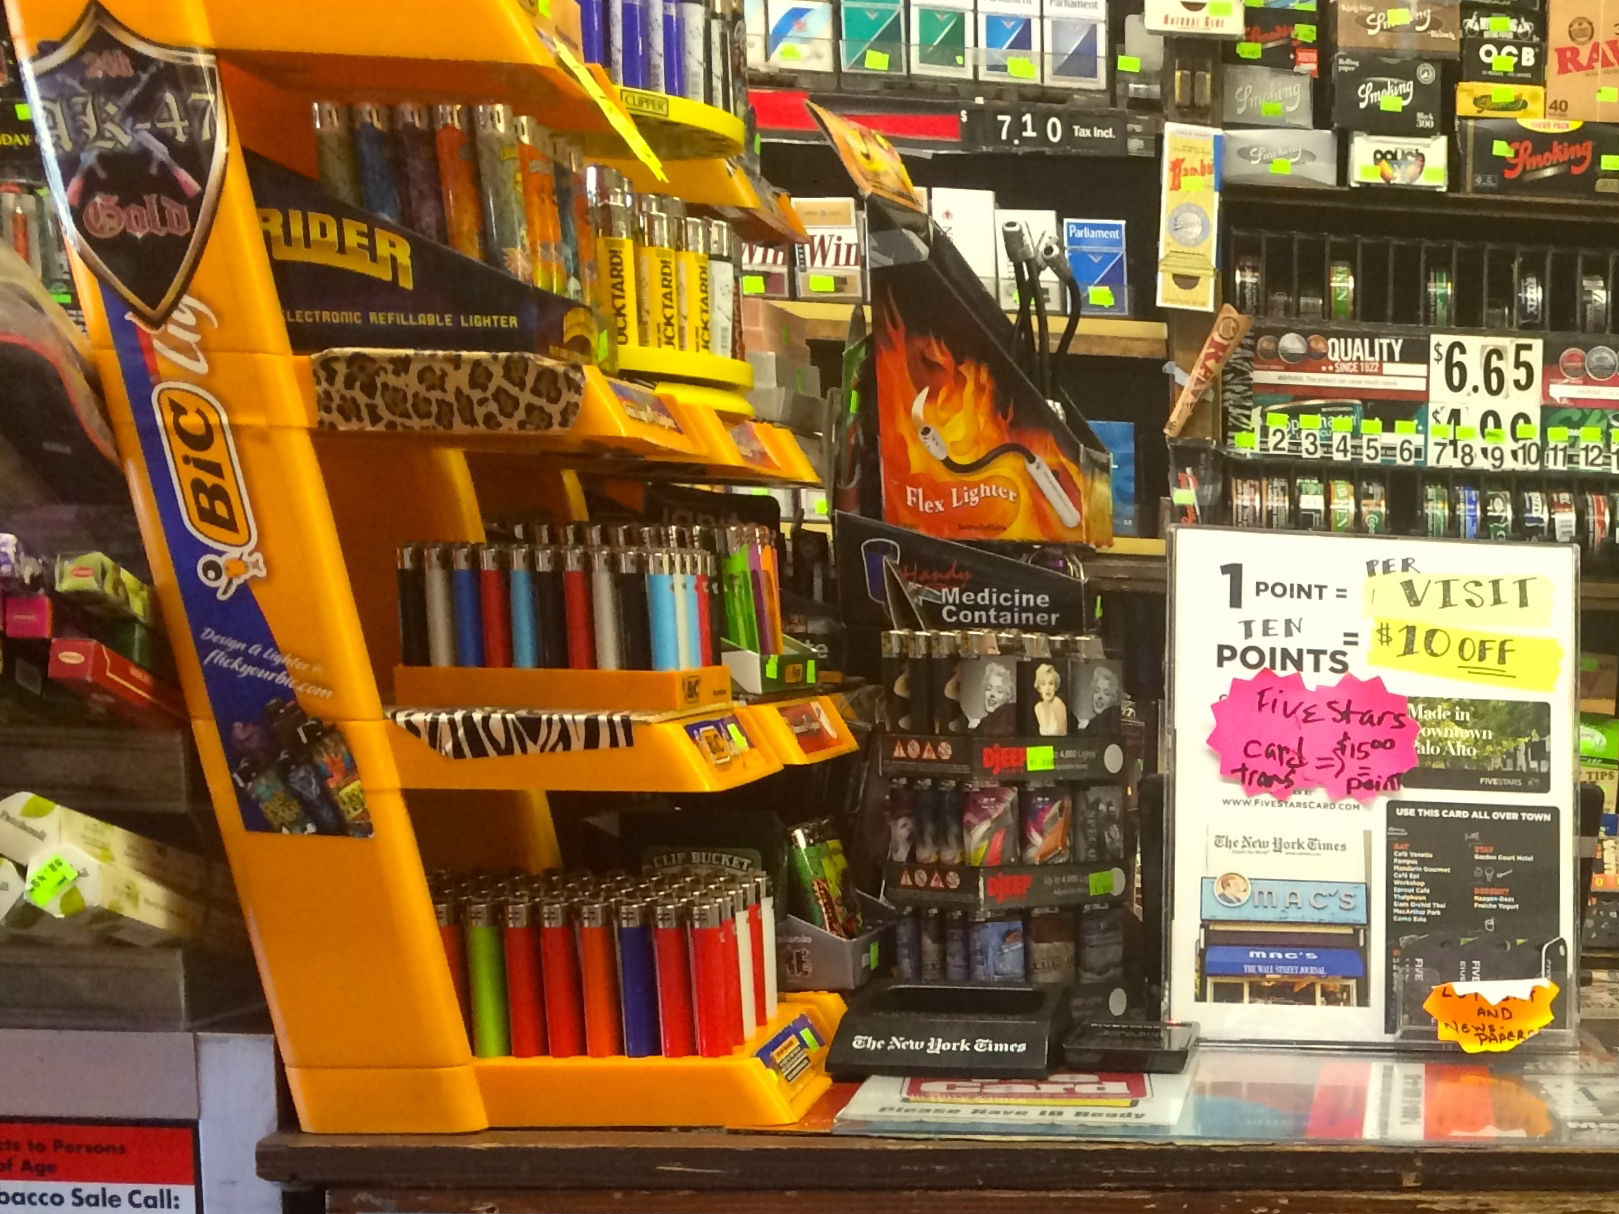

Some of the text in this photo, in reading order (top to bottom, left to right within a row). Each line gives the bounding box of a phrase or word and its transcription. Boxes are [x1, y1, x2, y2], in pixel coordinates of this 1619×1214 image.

[625, 94, 664, 111] CLIPPER
[997, 114, 1062, 145] 7.10
[1505, 138, 1591, 179] Smoking
[83, 194, 191, 238] Gold
[1069, 225, 1120, 239] Parliament
[369, 312, 518, 328] REFILLABLE LIGHTER
[1327, 338, 1403, 362] QUALITY
[1335, 362, 1379, 372] SINCE 1822
[1433, 340, 1535, 396] $6.65
[1272, 428, 1286, 450] 2
[1336, 435, 1350, 458] 4
[1434, 442, 1447, 465] 7
[1518, 442, 1540, 466] 10
[1549, 444, 1567, 467] 11
[169, 398, 239, 535] BiC
[906, 484, 1018, 513] Flex Lighter
[901, 560, 972, 588] Handy
[1366, 557, 1420, 577] PER
[1220, 563, 1328, 609] 1 POINT
[1400, 577, 1537, 608] VISIT
[942, 588, 1050, 607] Medicine
[942, 606, 1060, 626] Container
[1238, 618, 1304, 639] TEN
[1376, 622, 1516, 665] $10 OFF
[1217, 644, 1349, 673] POINTS
[204, 649, 333, 699] flickyourbic.com
[1445, 741, 1478, 757] Alto
[1396, 808, 1551, 821] USE THIS CARD ALL OVER TOWN
[1214, 835, 1239, 849] The
[1241, 836, 1269, 849] New
[1273, 837, 1305, 853] York
[1307, 838, 1347, 851] Times
[653, 851, 751, 871] CLIP BUCKET
[1477, 1007, 1512, 1020] AND
[852, 1035, 1027, 1054] The New York Times
[53, 1141, 125, 1155] Persons
[21, 1160, 57, 1175] Age
[71, 1188, 180, 1209] Sale Call:
